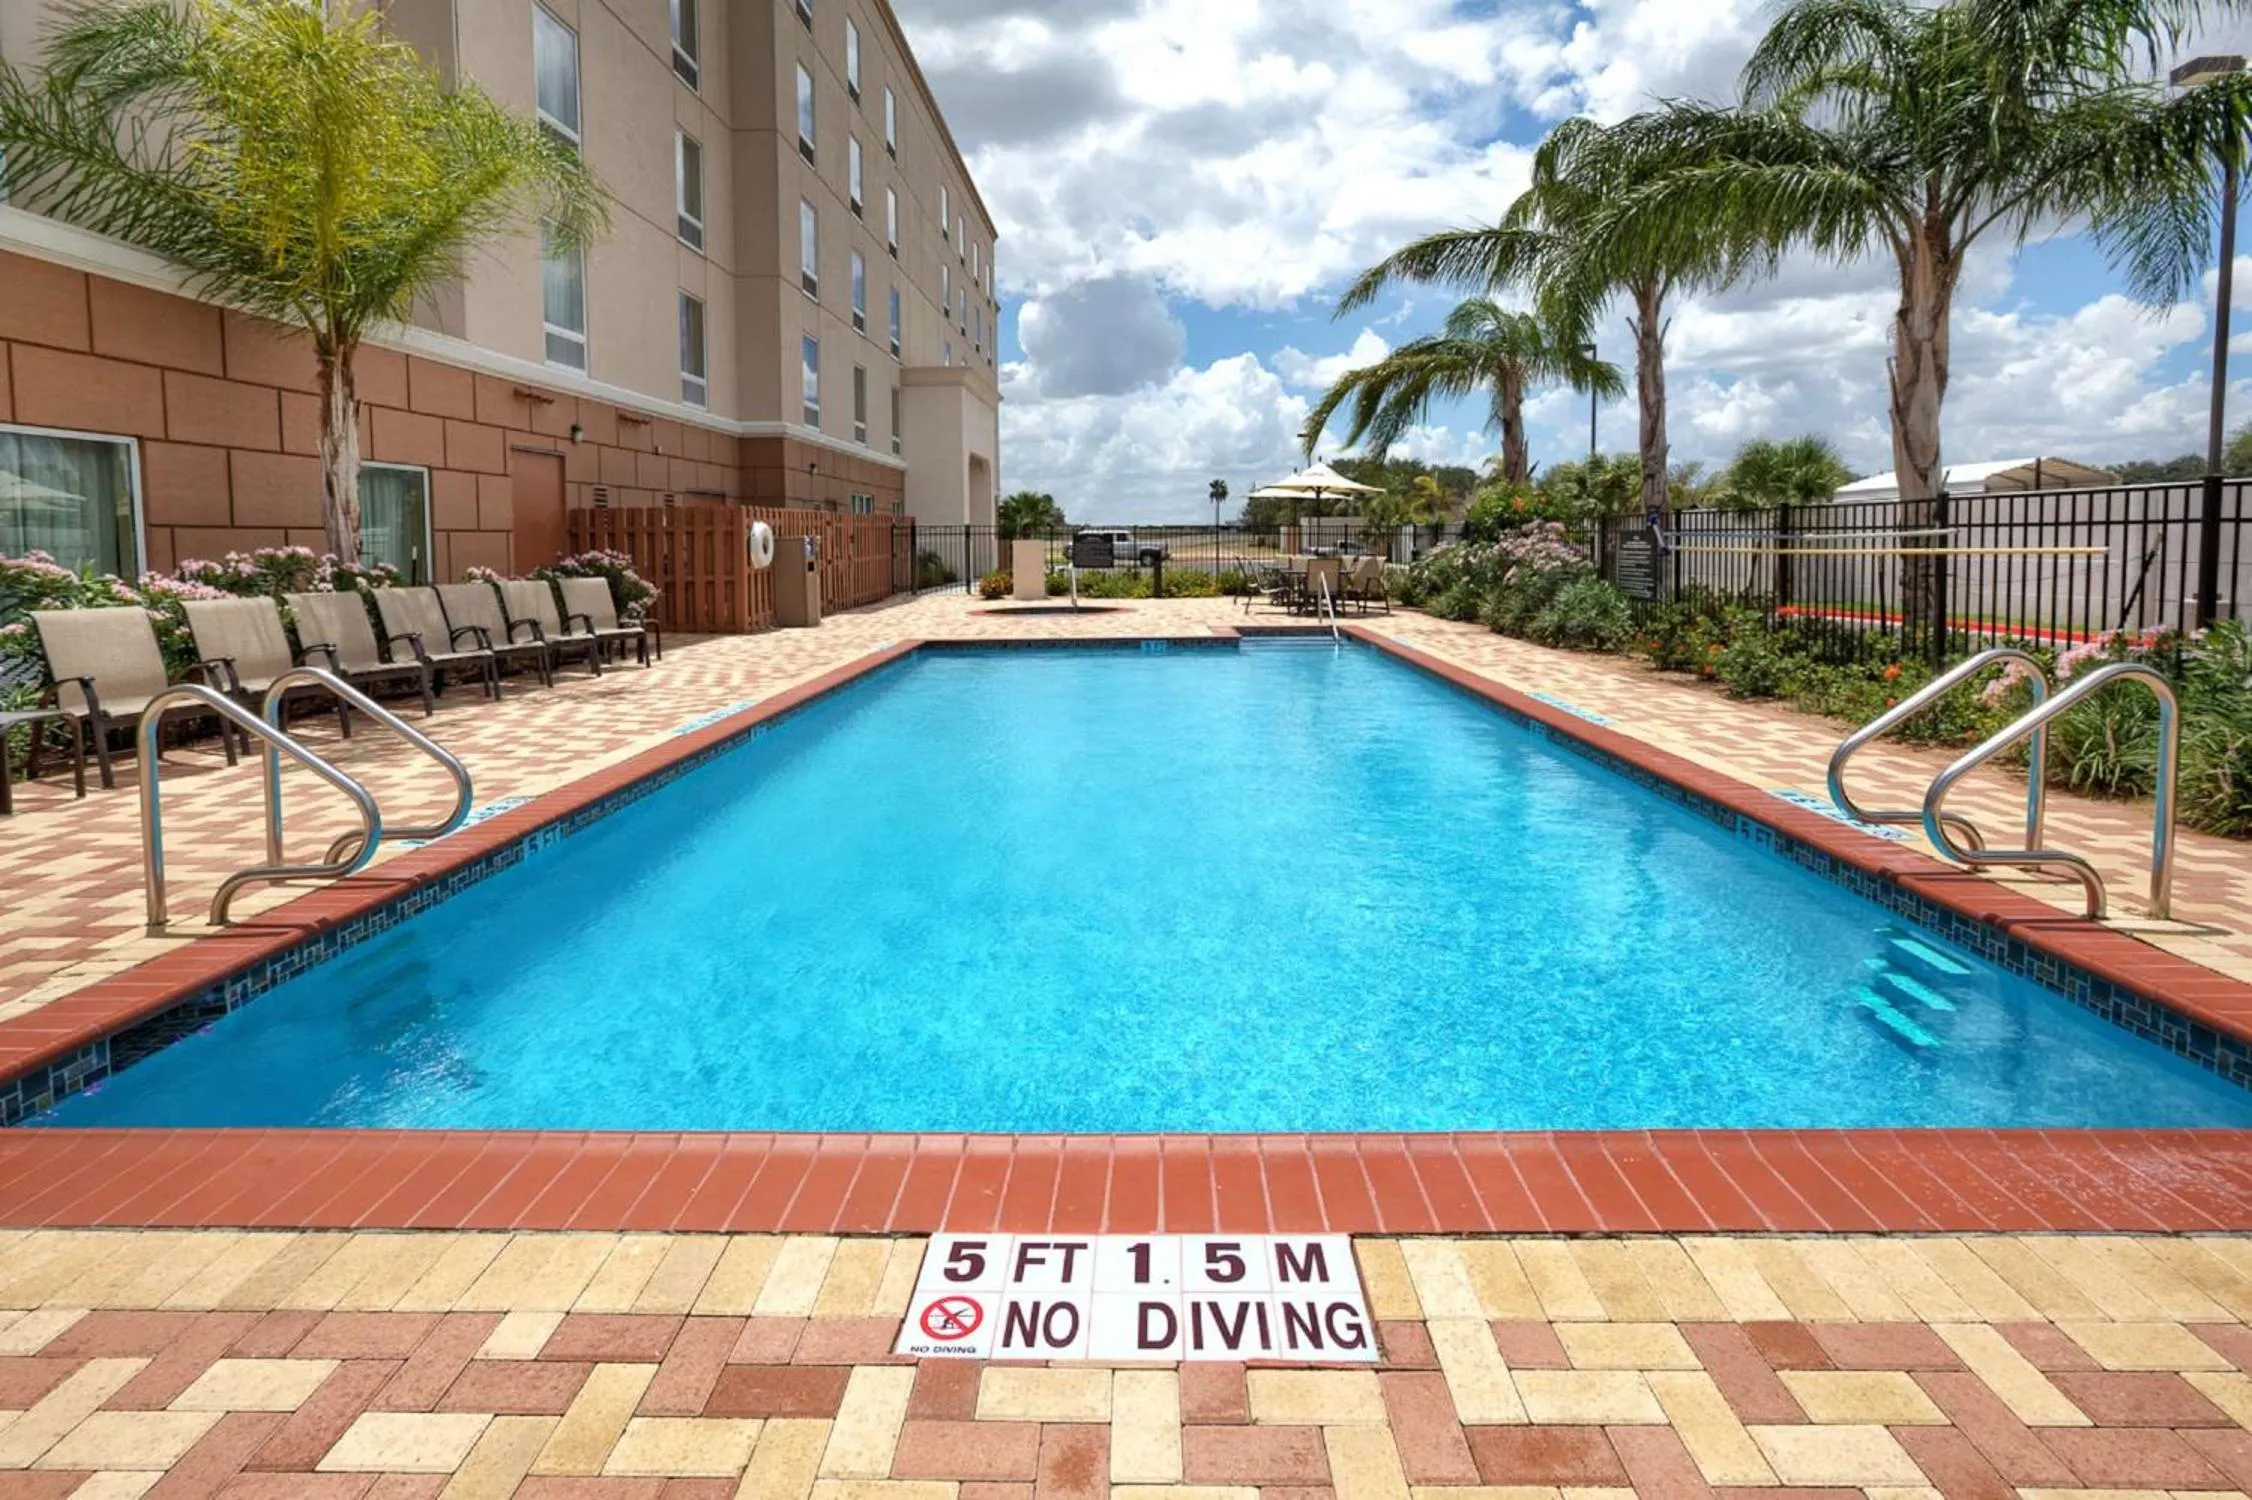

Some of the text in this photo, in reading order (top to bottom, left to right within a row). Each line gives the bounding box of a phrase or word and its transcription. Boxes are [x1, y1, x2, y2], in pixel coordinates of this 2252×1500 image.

[943, 1241, 988, 1283] 5
[1013, 1242, 1089, 1284] FT
[1274, 1242, 1330, 1283] M
[1002, 1301, 1368, 1350] NO DIVING
[932, 1346, 977, 1354] DIVING
